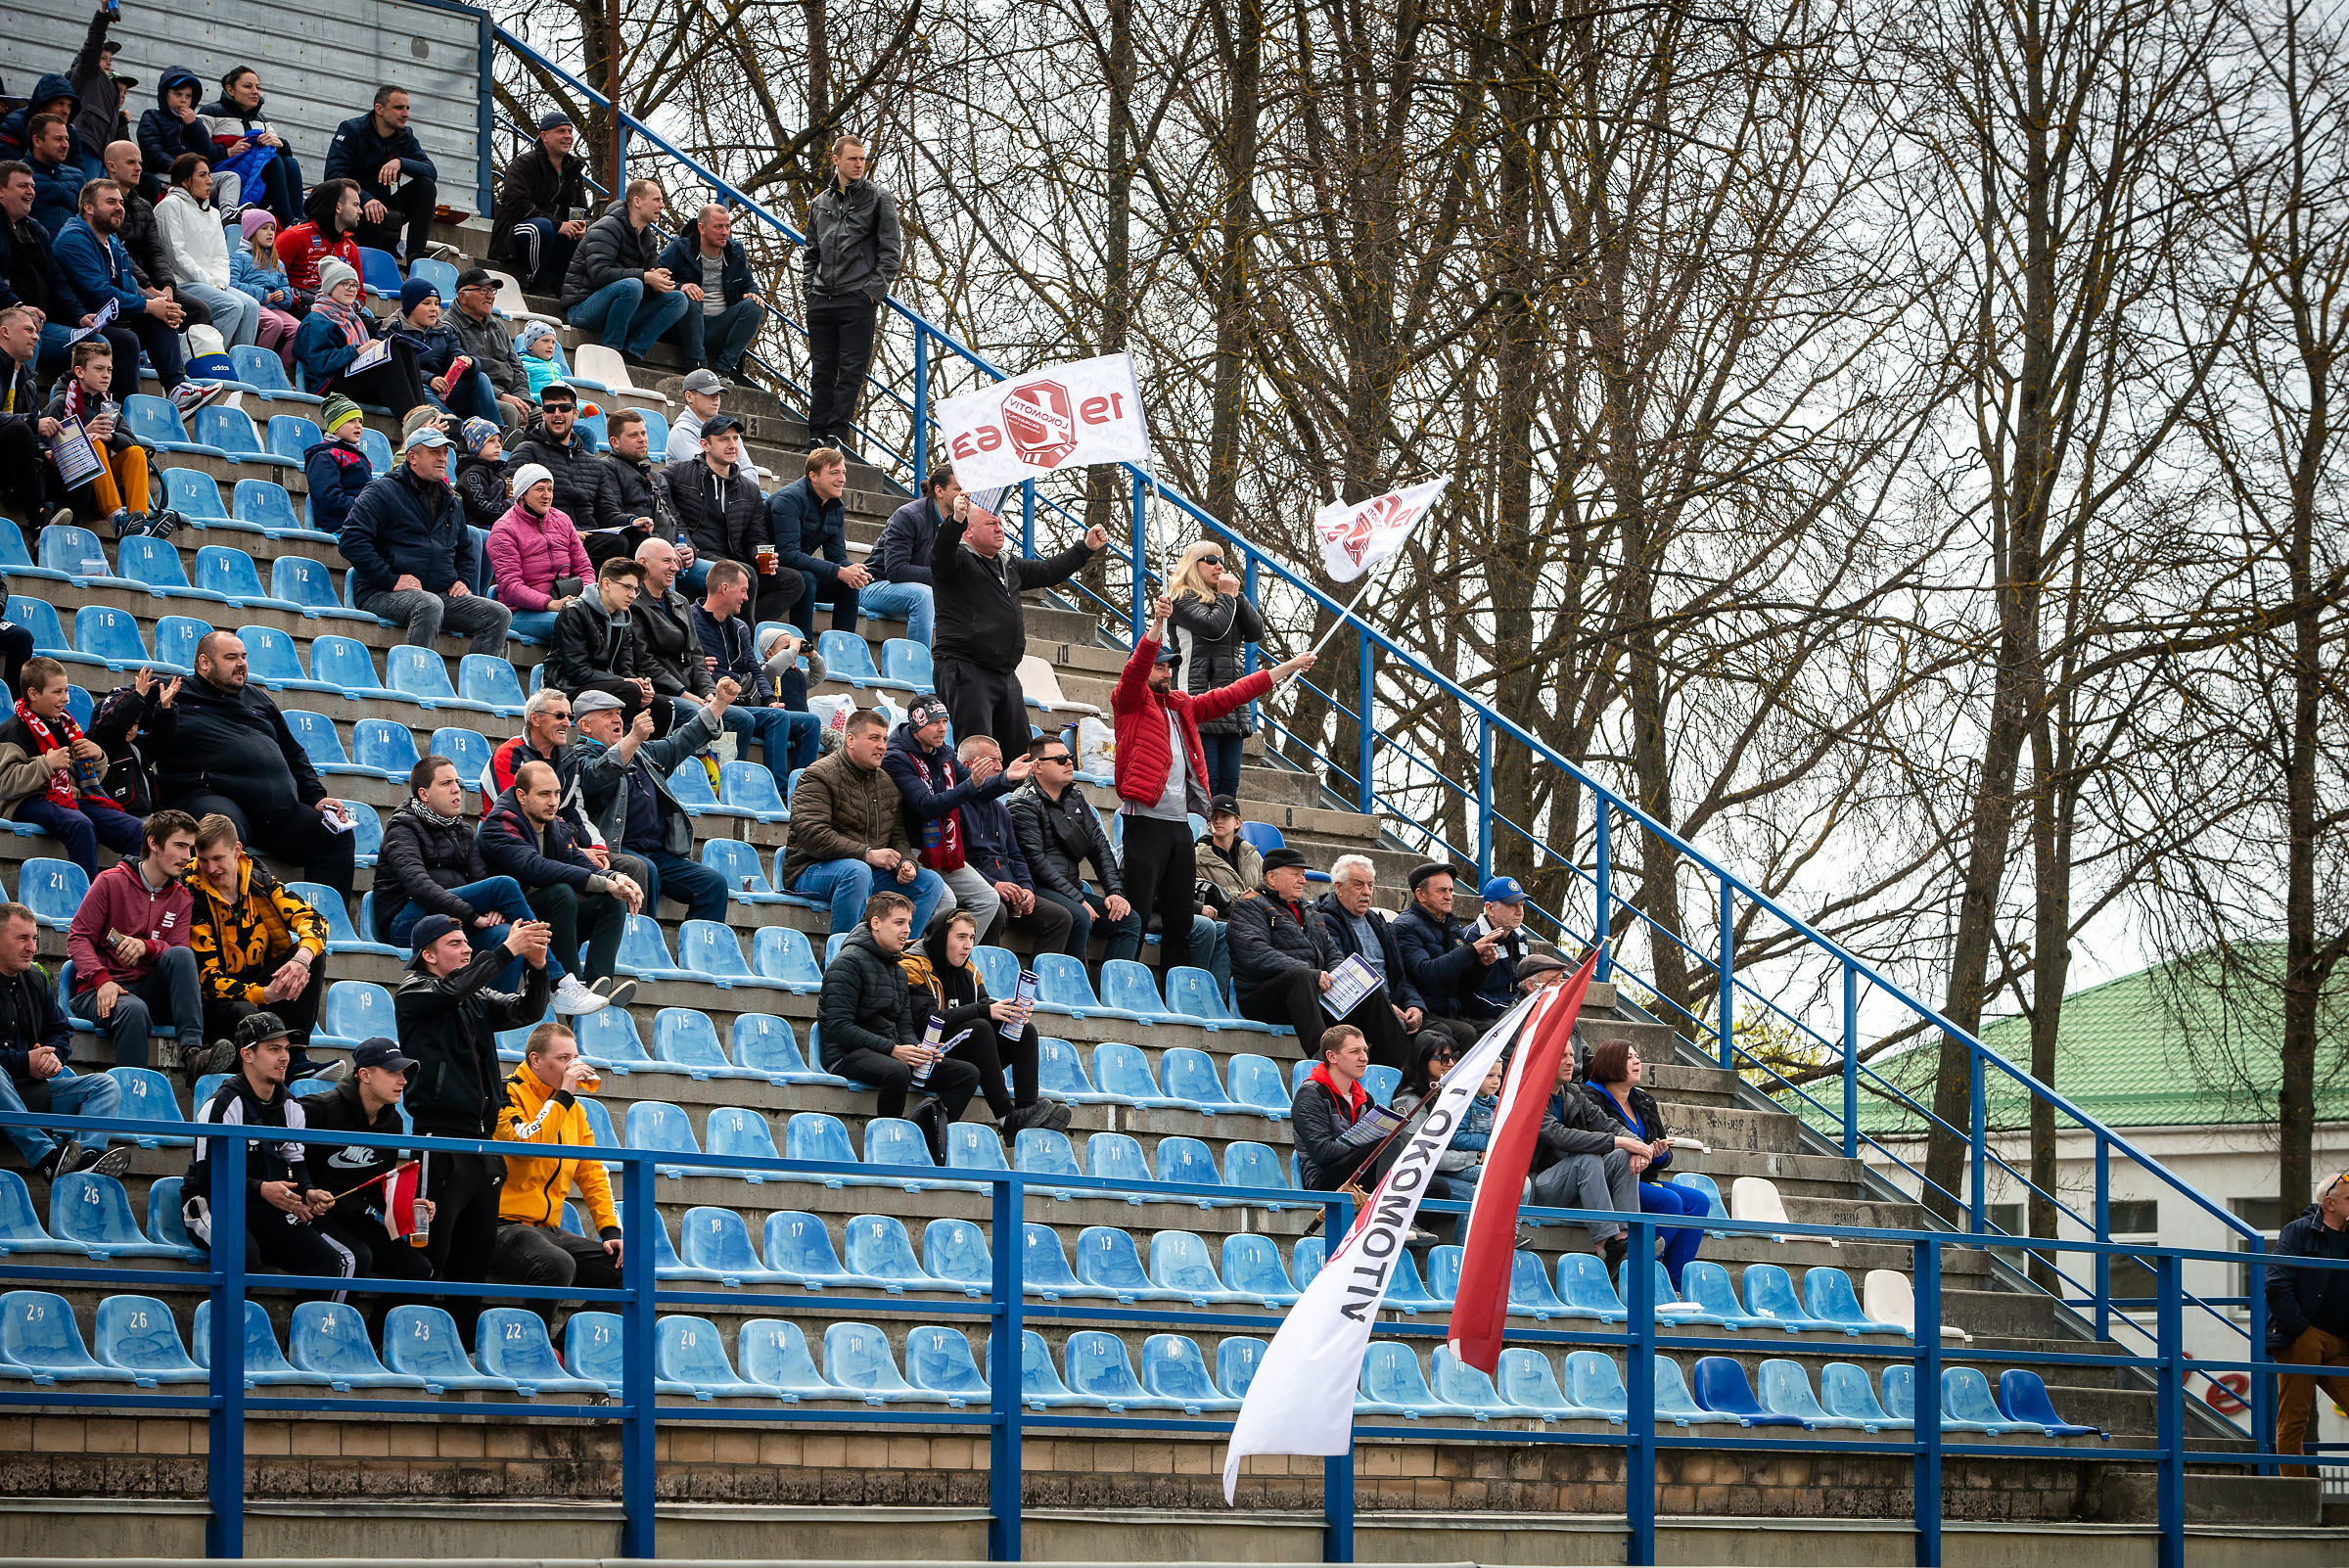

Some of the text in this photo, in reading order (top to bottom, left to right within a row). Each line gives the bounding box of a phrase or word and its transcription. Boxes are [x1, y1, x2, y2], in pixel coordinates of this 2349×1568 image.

[295, 425, 299, 437] 9
[362, 440, 367, 451] 8
[186, 484, 196, 496] 12
[257, 492, 263, 505] 11
[850, 493, 864, 510] 12
[67, 533, 77, 545] 15
[144, 546, 153, 559] 14
[297, 568, 307, 581] 12
[23, 605, 33, 619] 17
[100, 614, 114, 626] 16
[181, 625, 193, 638] 15
[335, 644, 344, 657] 13
[1056, 645, 1069, 664] 10
[413, 654, 425, 668] 12
[486, 666, 493, 680] 11
[300, 717, 311, 730] 15
[455, 737, 466, 752] 13
[745, 771, 750, 782] 9
[727, 853, 736, 866] 11
[51, 873, 63, 889] 21
[704, 928, 714, 945] 13
[778, 936, 789, 952] 12
[990, 956, 995, 968] 9
[1128, 977, 1132, 987] 7
[1191, 979, 1195, 990] 6
[361, 992, 371, 1010] 19
[599, 1013, 609, 1027] 16
[677, 1015, 688, 1030] 15
[1118, 1056, 1123, 1068] 9
[1254, 1067, 1258, 1080] 7
[1380, 1077, 1385, 1088] 5
[653, 1111, 664, 1126] 17
[731, 1118, 743, 1131] 16
[813, 1119, 823, 1134] 15
[967, 1133, 977, 1147] 13
[341, 1145, 375, 1163] NIKE
[1112, 1147, 1120, 1160] 11
[1182, 1150, 1191, 1165] 10
[1775, 1157, 1782, 1176] 4
[712, 1220, 721, 1233] 18
[792, 1222, 803, 1237] 17
[872, 1223, 883, 1237] 16
[1101, 1236, 1111, 1250] 13
[1452, 1255, 1457, 1268] 8
[1579, 1263, 1584, 1274] 6
[131, 1313, 147, 1328] 26
[415, 1320, 429, 1340] 23
[506, 1323, 521, 1339] 22
[595, 1325, 608, 1342] 21
[681, 1330, 695, 1347] 20
[934, 1335, 944, 1350] 17
[1093, 1341, 1104, 1355] 15
[1243, 1349, 1252, 1362] 13
[1387, 1355, 1395, 1368] 11
[1524, 1360, 1530, 1371] 9
[1589, 1361, 1594, 1374] 8
[1905, 1372, 1909, 1383] 3
